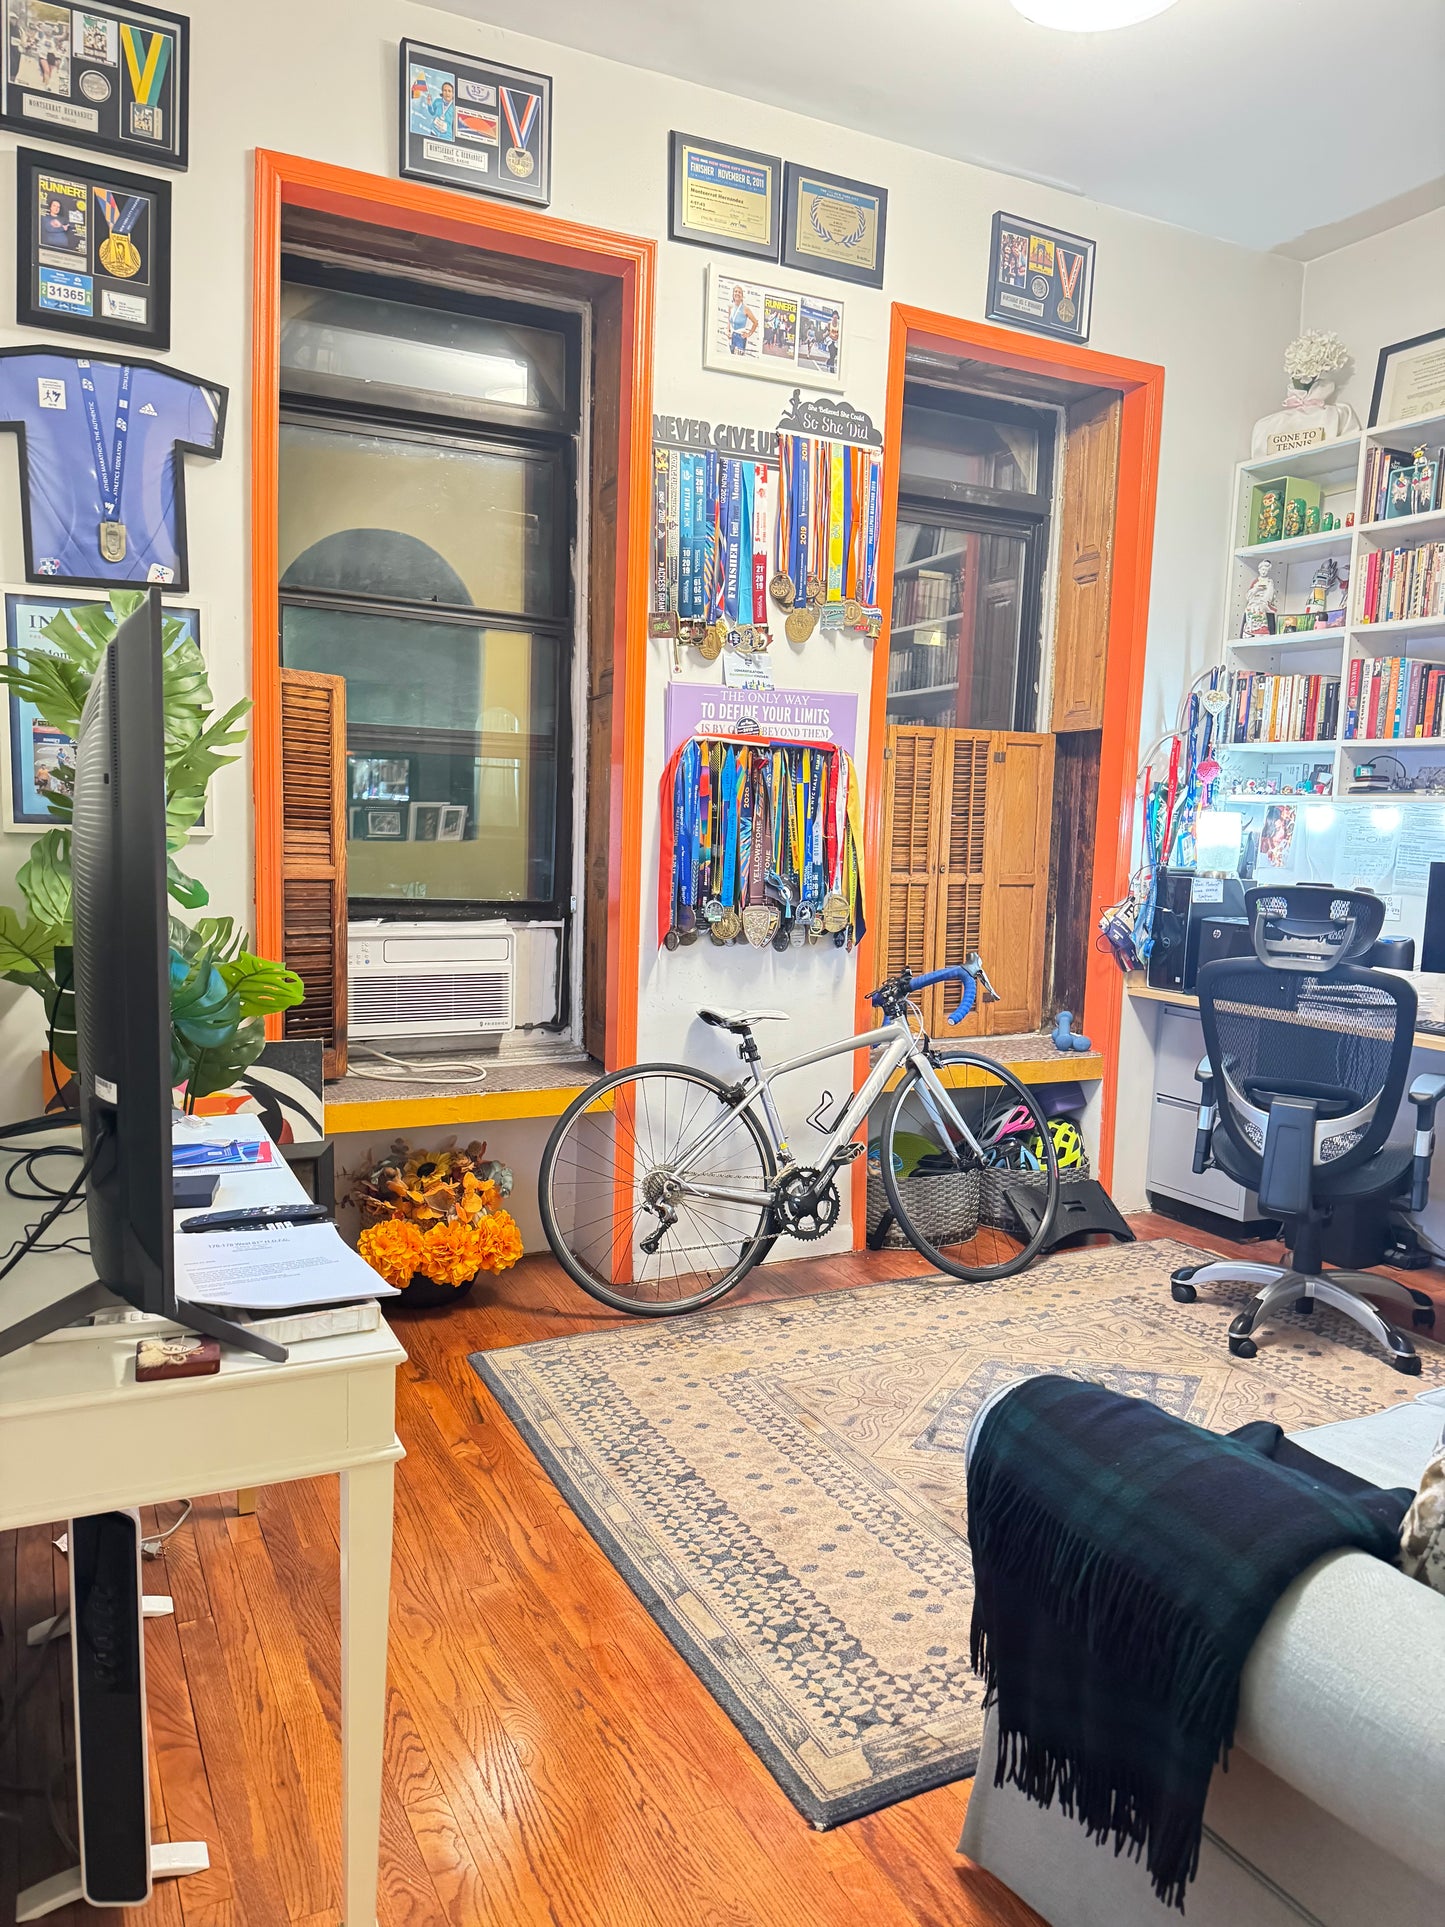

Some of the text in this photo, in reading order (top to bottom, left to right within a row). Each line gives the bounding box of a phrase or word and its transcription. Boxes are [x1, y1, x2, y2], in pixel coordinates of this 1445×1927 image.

[690, 162, 714, 176] FINISHER
[718, 168, 745, 183] NOVEMBER
[753, 177, 764, 188] 2011
[49, 285, 84, 301] 31365
[88, 401, 99, 431] AUTHENTIC
[807, 404, 865, 422] She Believed She Could
[653, 414, 779, 454] NEVER GIVE UP
[803, 413, 868, 440] So She Did
[1273, 430, 1316, 443] GONE TO
[1276, 440, 1312, 451] TENNIS
[731, 462, 740, 500] Montauk
[728, 543, 738, 599] FINISHER
[1397, 667, 1405, 690] KORAN
[720, 691, 810, 706] THE ONLY WAY
[701, 702, 830, 725] TO DEFINE YOUR LIMITS
[701, 724, 710, 733] IS
[712, 724, 725, 733] BY
[762, 727, 800, 738] BEYOND
[803, 729, 829, 739] THEM
[753, 820, 761, 884] YELLOWSTONE
